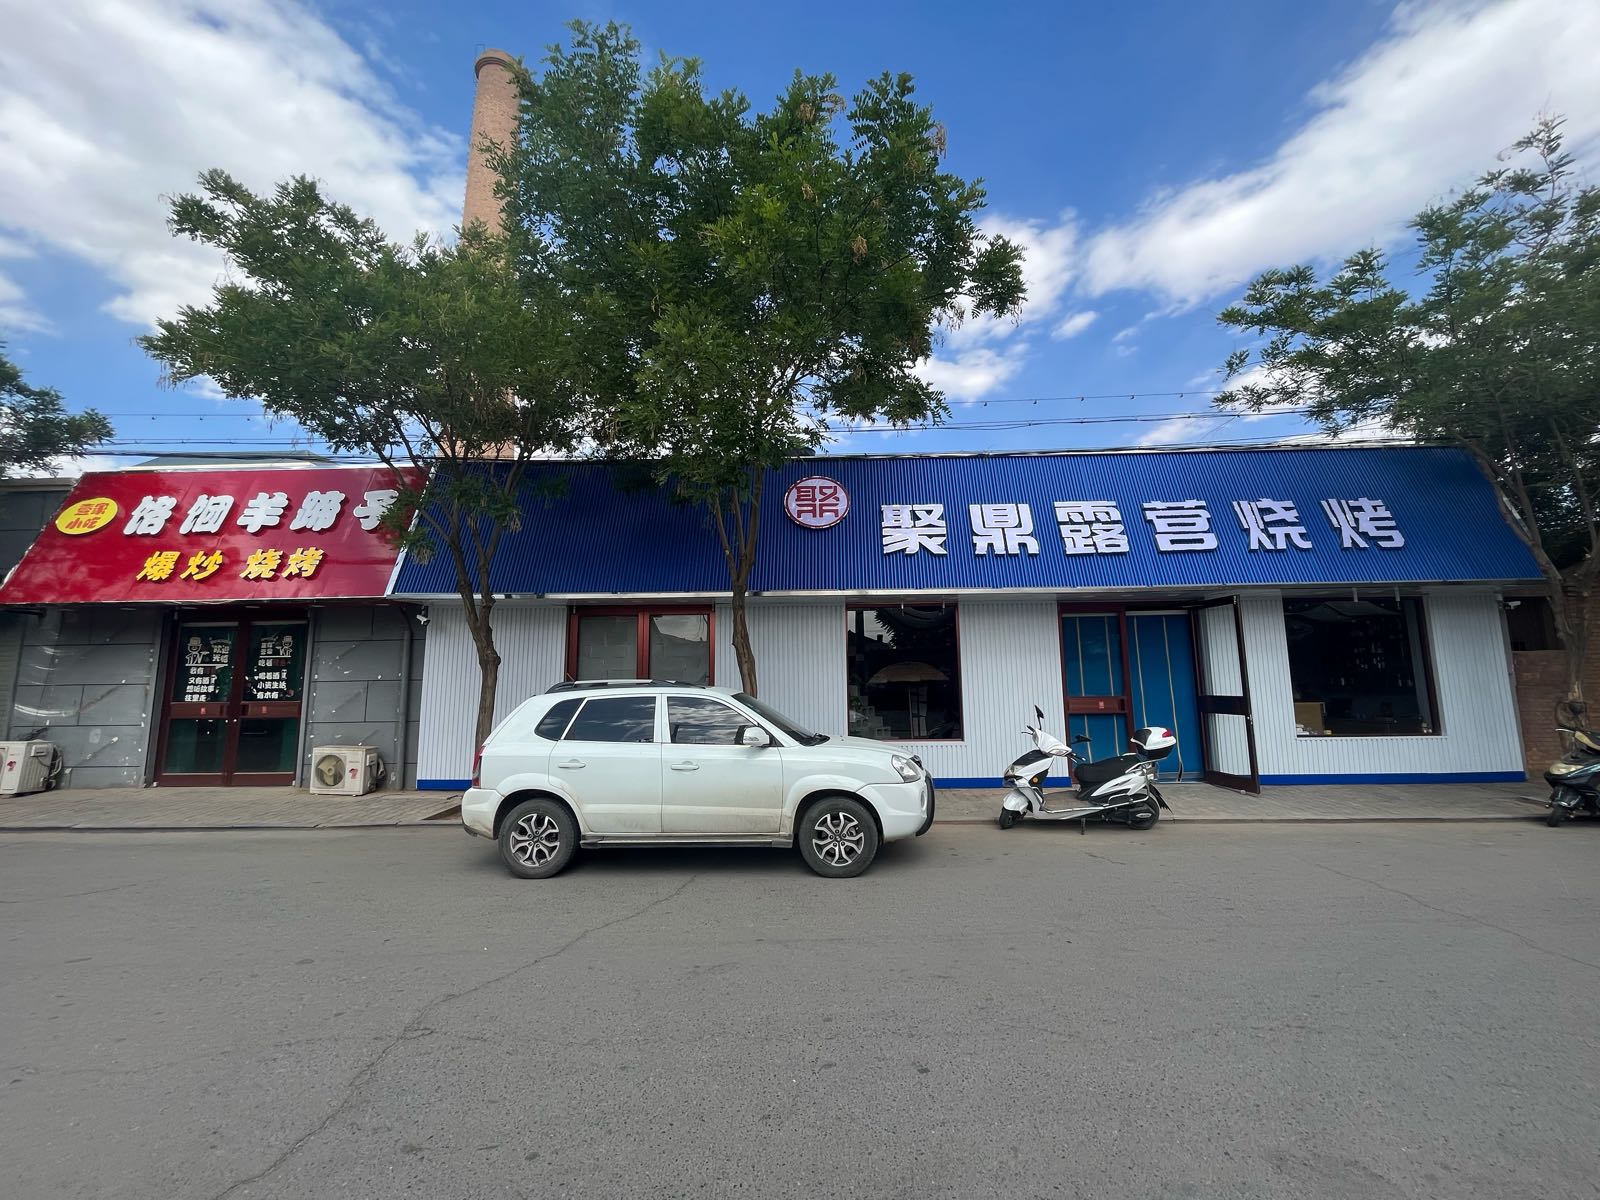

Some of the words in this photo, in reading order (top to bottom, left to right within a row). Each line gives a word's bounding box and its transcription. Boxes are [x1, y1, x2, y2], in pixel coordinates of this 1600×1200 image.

[880, 498, 1406, 555] 聚鼎露营烧烤
[136, 550, 222, 581] 爆炒
[240, 547, 325, 579] 烧烤
